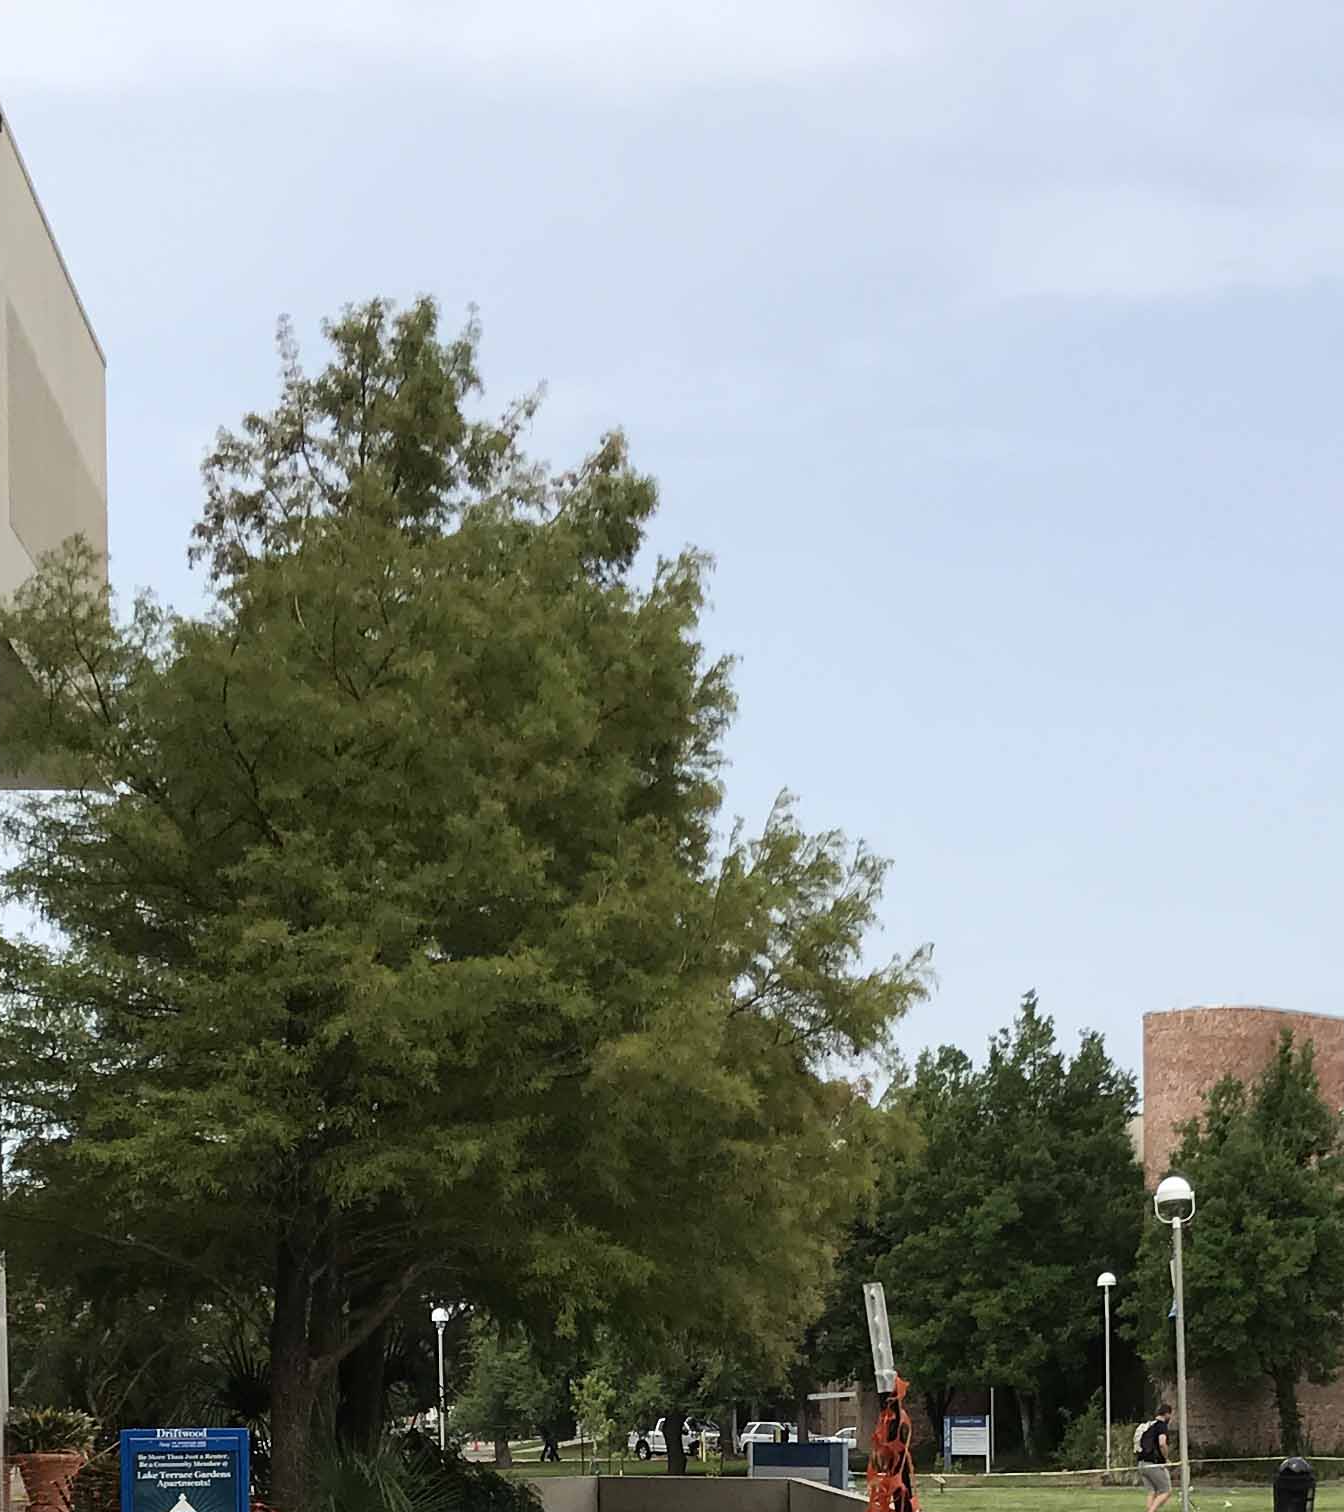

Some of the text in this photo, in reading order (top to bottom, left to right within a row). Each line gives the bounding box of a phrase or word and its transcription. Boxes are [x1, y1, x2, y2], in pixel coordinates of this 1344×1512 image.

[156, 1428, 207, 1438] Driftwood
[137, 1470, 232, 1479] Lake Terrace Gardens
[157, 1479, 211, 1488] Apartments!
